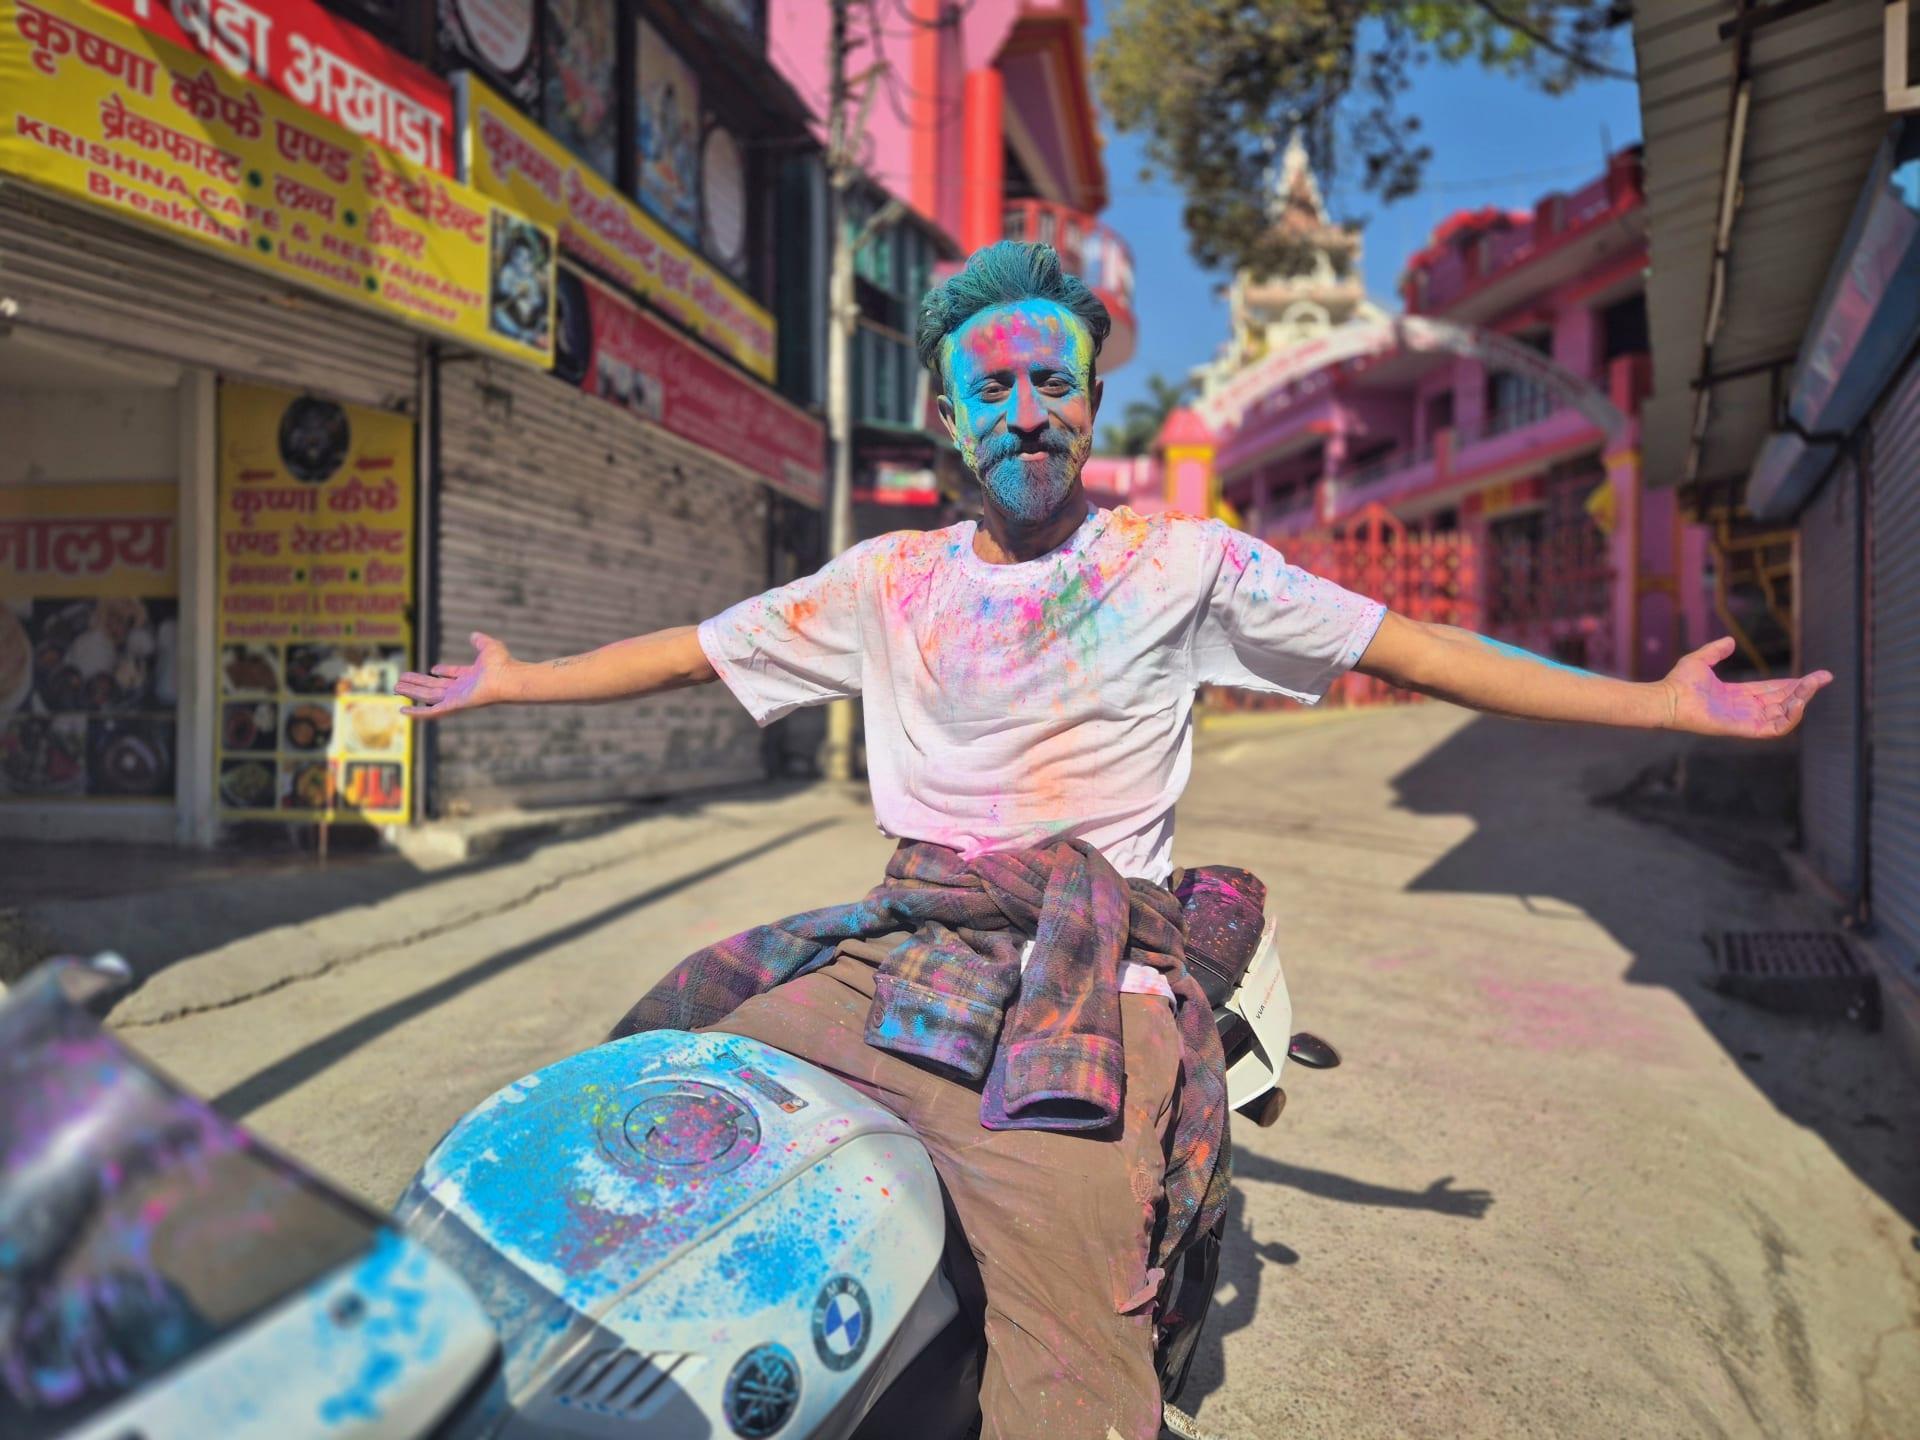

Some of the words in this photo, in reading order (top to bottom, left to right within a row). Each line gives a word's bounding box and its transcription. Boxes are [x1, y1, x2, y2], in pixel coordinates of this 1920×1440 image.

[15, 1, 160, 97] कृष्णा
[169, 69, 264, 140] कैफे
[274, 119, 353, 185] एण्ड
[16, 115, 189, 198] KRISHNA
[322, 232, 484, 310] RESTAURANT
[88, 169, 250, 249] Breakfast
[278, 240, 362, 288] Lunch
[232, 486, 319, 526] कृष्णा
